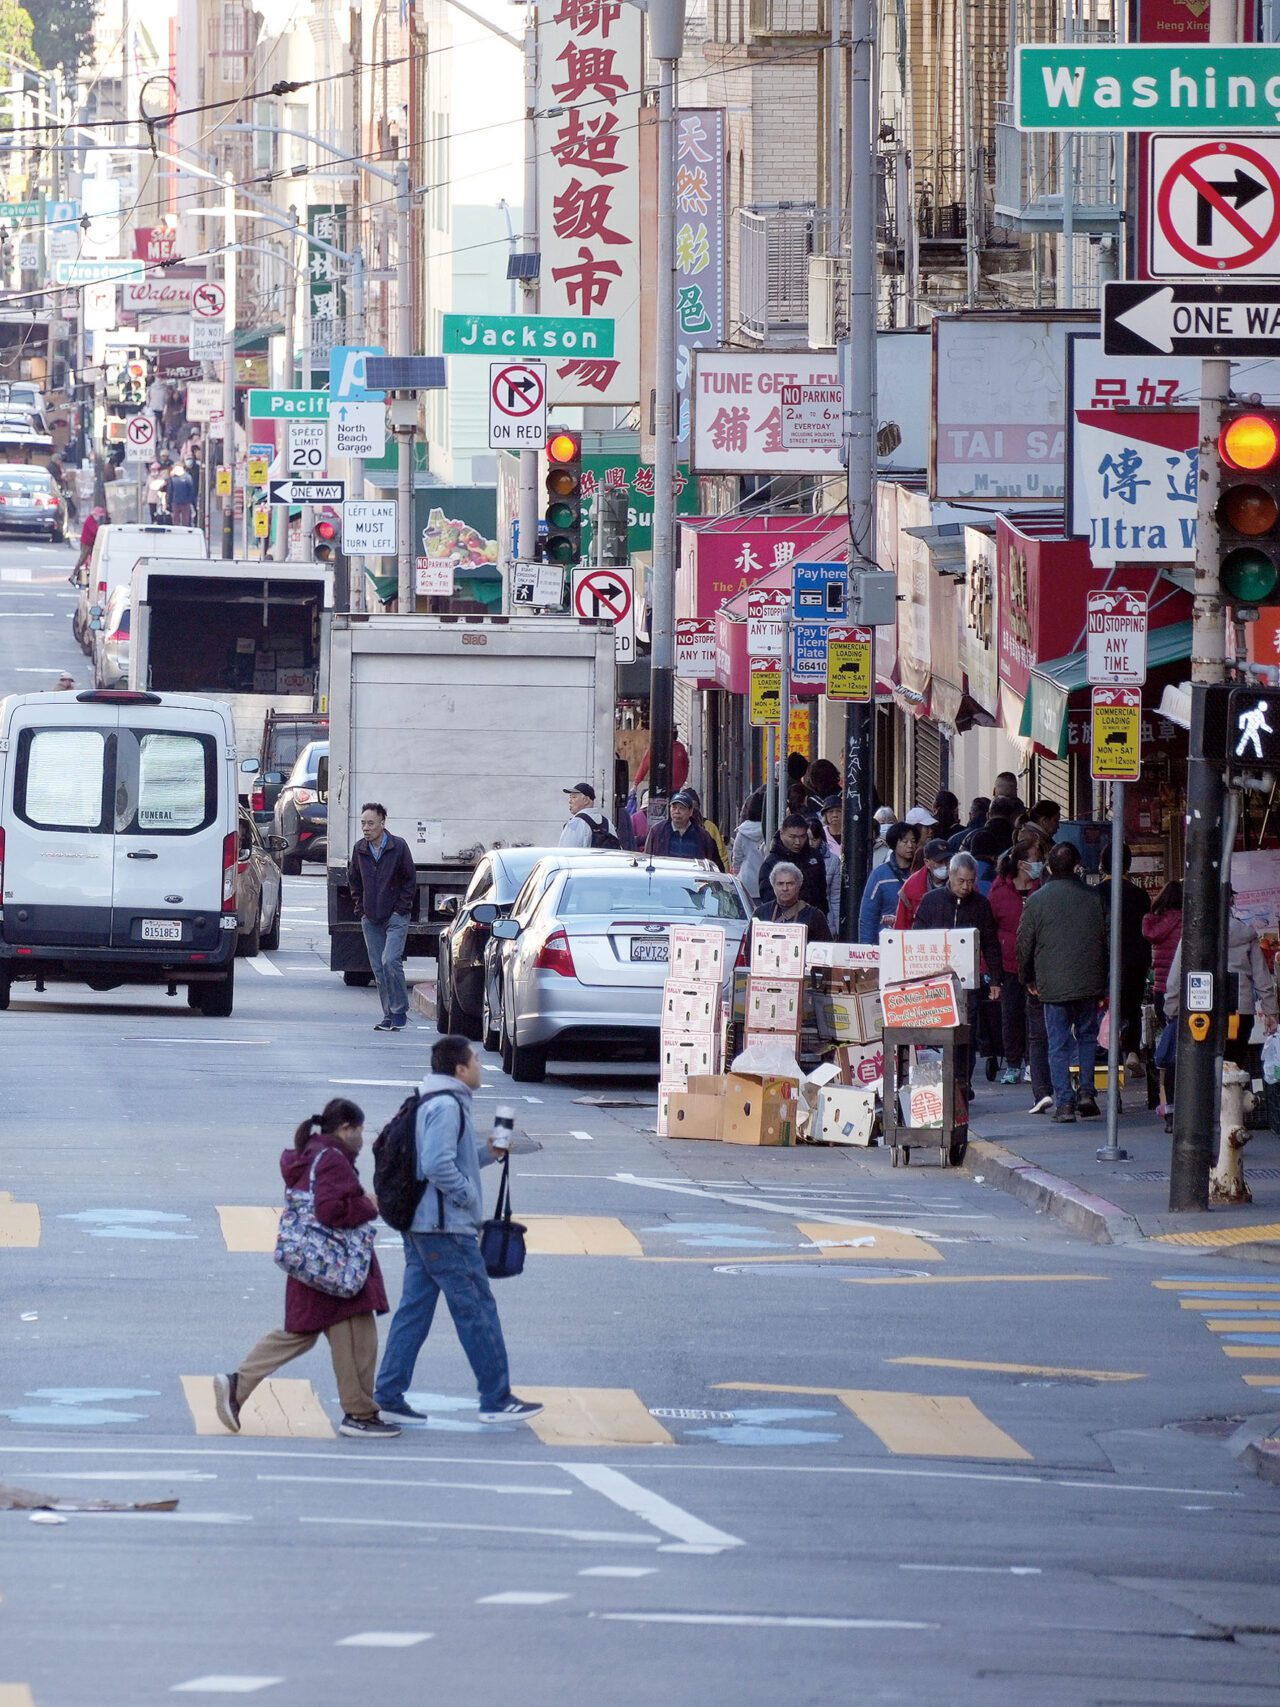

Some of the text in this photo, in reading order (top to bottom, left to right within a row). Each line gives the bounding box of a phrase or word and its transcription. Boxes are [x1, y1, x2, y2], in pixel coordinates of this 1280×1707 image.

[1157, 21, 1210, 32] Heng Xing
[21, 256, 36, 267] 20
[68, 266, 134, 279] Broadway
[1173, 307, 1233, 334] ONE
[460, 323, 597, 349] Jackson
[700, 372, 798, 394] TUNE GET
[784, 387, 842, 404] NO PARKING
[271, 396, 330, 412] Pacifi
[786, 407, 803, 420] 2AM
[823, 407, 840, 420] 6AM
[291, 428, 324, 436] SPEED
[337, 424, 365, 433] North
[493, 426, 542, 438] ON RED
[706, 405, 833, 453] 鋪金
[295, 438, 319, 446] LIMIT
[337, 433, 368, 442] Beach
[337, 443, 372, 453] Garage
[947, 431, 1004, 459] TAI
[293, 449, 322, 466] 20
[290, 486, 338, 498] ONE WAY
[348, 507, 393, 517] LEFT LANE
[355, 523, 384, 533] MUST
[346, 539, 392, 548] TURN LEFT
[417, 558, 453, 569] NO PARKING
[797, 567, 847, 580] Pay here
[713, 582, 733, 592] The
[750, 607, 789, 618] NO STOPPIN
[1088, 613, 1145, 633] NO STOPPING
[750, 625, 782, 635] ANY TIM
[797, 627, 827, 639] Pay b
[677, 634, 693, 644] NO
[830, 643, 868, 651] COMMERCIAL
[1106, 638, 1128, 653] ANY
[680, 650, 716, 660] ANY TIM
[797, 648, 824, 659] Plate
[835, 650, 862, 658] LOADING
[798, 661, 827, 672] 66410
[1104, 656, 1130, 671] TIME
[1095, 707, 1137, 716] COMMERCIAL
[1102, 717, 1131, 725] LOADING
[1096, 757, 1137, 765] 7AM 12NOON
[140, 811, 173, 820] FUNERAL
[144, 927, 180, 939] 81518E3
[849, 951, 865, 959] BALLY
